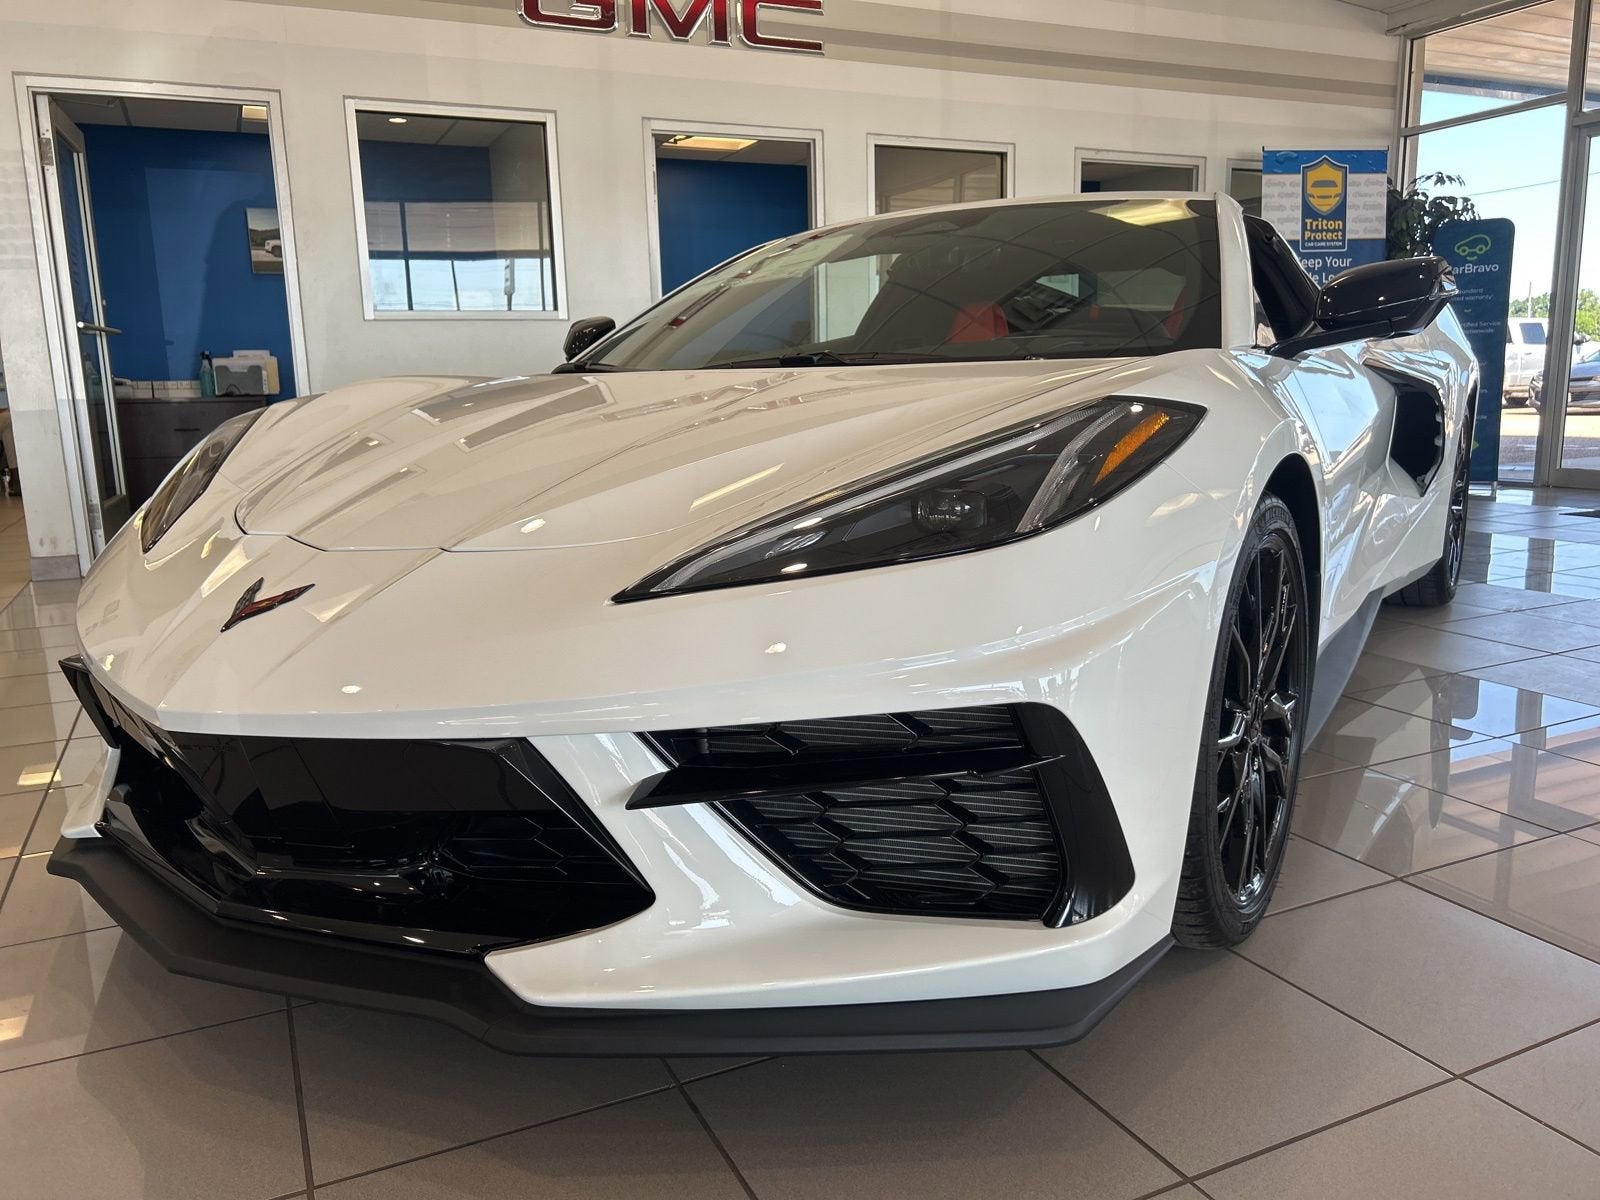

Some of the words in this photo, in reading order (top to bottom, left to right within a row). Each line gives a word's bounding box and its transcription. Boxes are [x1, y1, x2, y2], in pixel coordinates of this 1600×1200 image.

[517, 0, 825, 55] GMC
[1305, 218, 1343, 230] Triton
[1304, 231, 1343, 240] Protect
[1325, 256, 1352, 267] Your
[1452, 263, 1499, 274] arBravo
